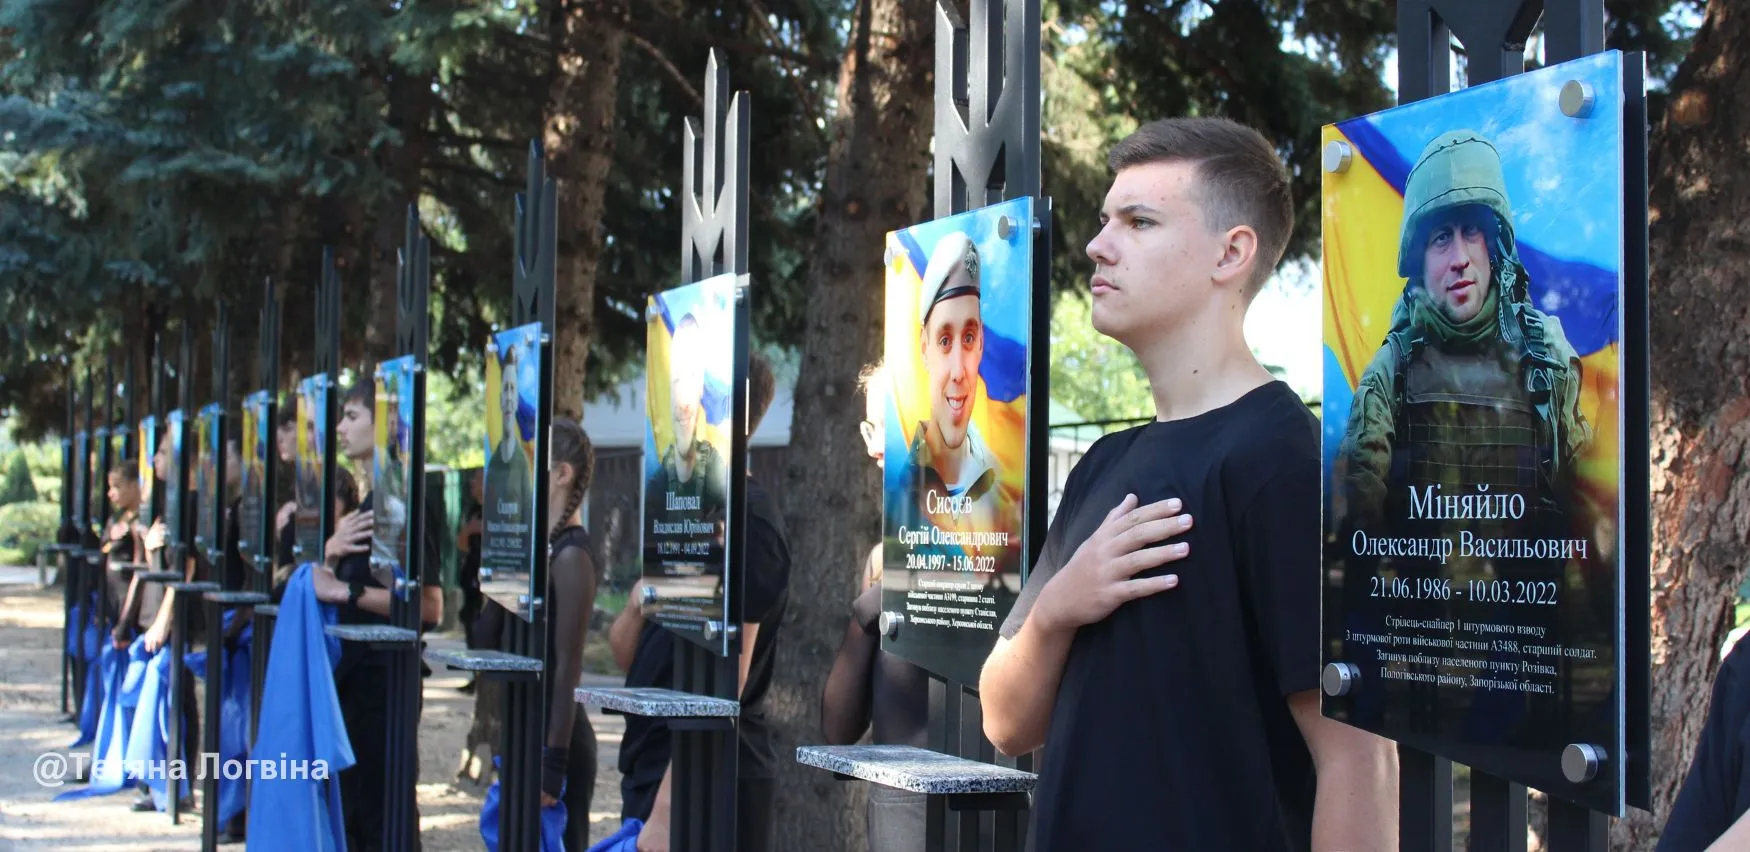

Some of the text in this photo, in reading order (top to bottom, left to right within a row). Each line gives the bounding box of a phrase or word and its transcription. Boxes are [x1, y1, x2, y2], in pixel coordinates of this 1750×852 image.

[666, 492, 700, 511] Шаповал
[926, 489, 973, 514] Сисоєв
[1408, 483, 1525, 520] Міняйло
[899, 526, 1008, 551] Сергій Олександрович
[1352, 530, 1588, 564] Олександр Васильович
[906, 554, 946, 570] 20.04.1997
[952, 556, 995, 573] 15.06.2022
[1370, 576, 1450, 600] 21.06.1986
[1468, 580, 1557, 604] 10.03.2022
[1385, 614, 1454, 632] Стрілець-снайпер
[1463, 622, 1515, 636] штурмового
[1517, 626, 1546, 639] взводу
[1345, 630, 1597, 659] 3 штурмової роти військової частини А3488, старший солдат.
[1376, 649, 1558, 676] Загинув поблизу населеного пункту Розівка,
[1380, 667, 1555, 694] Пологівського району, Запорізької області.
